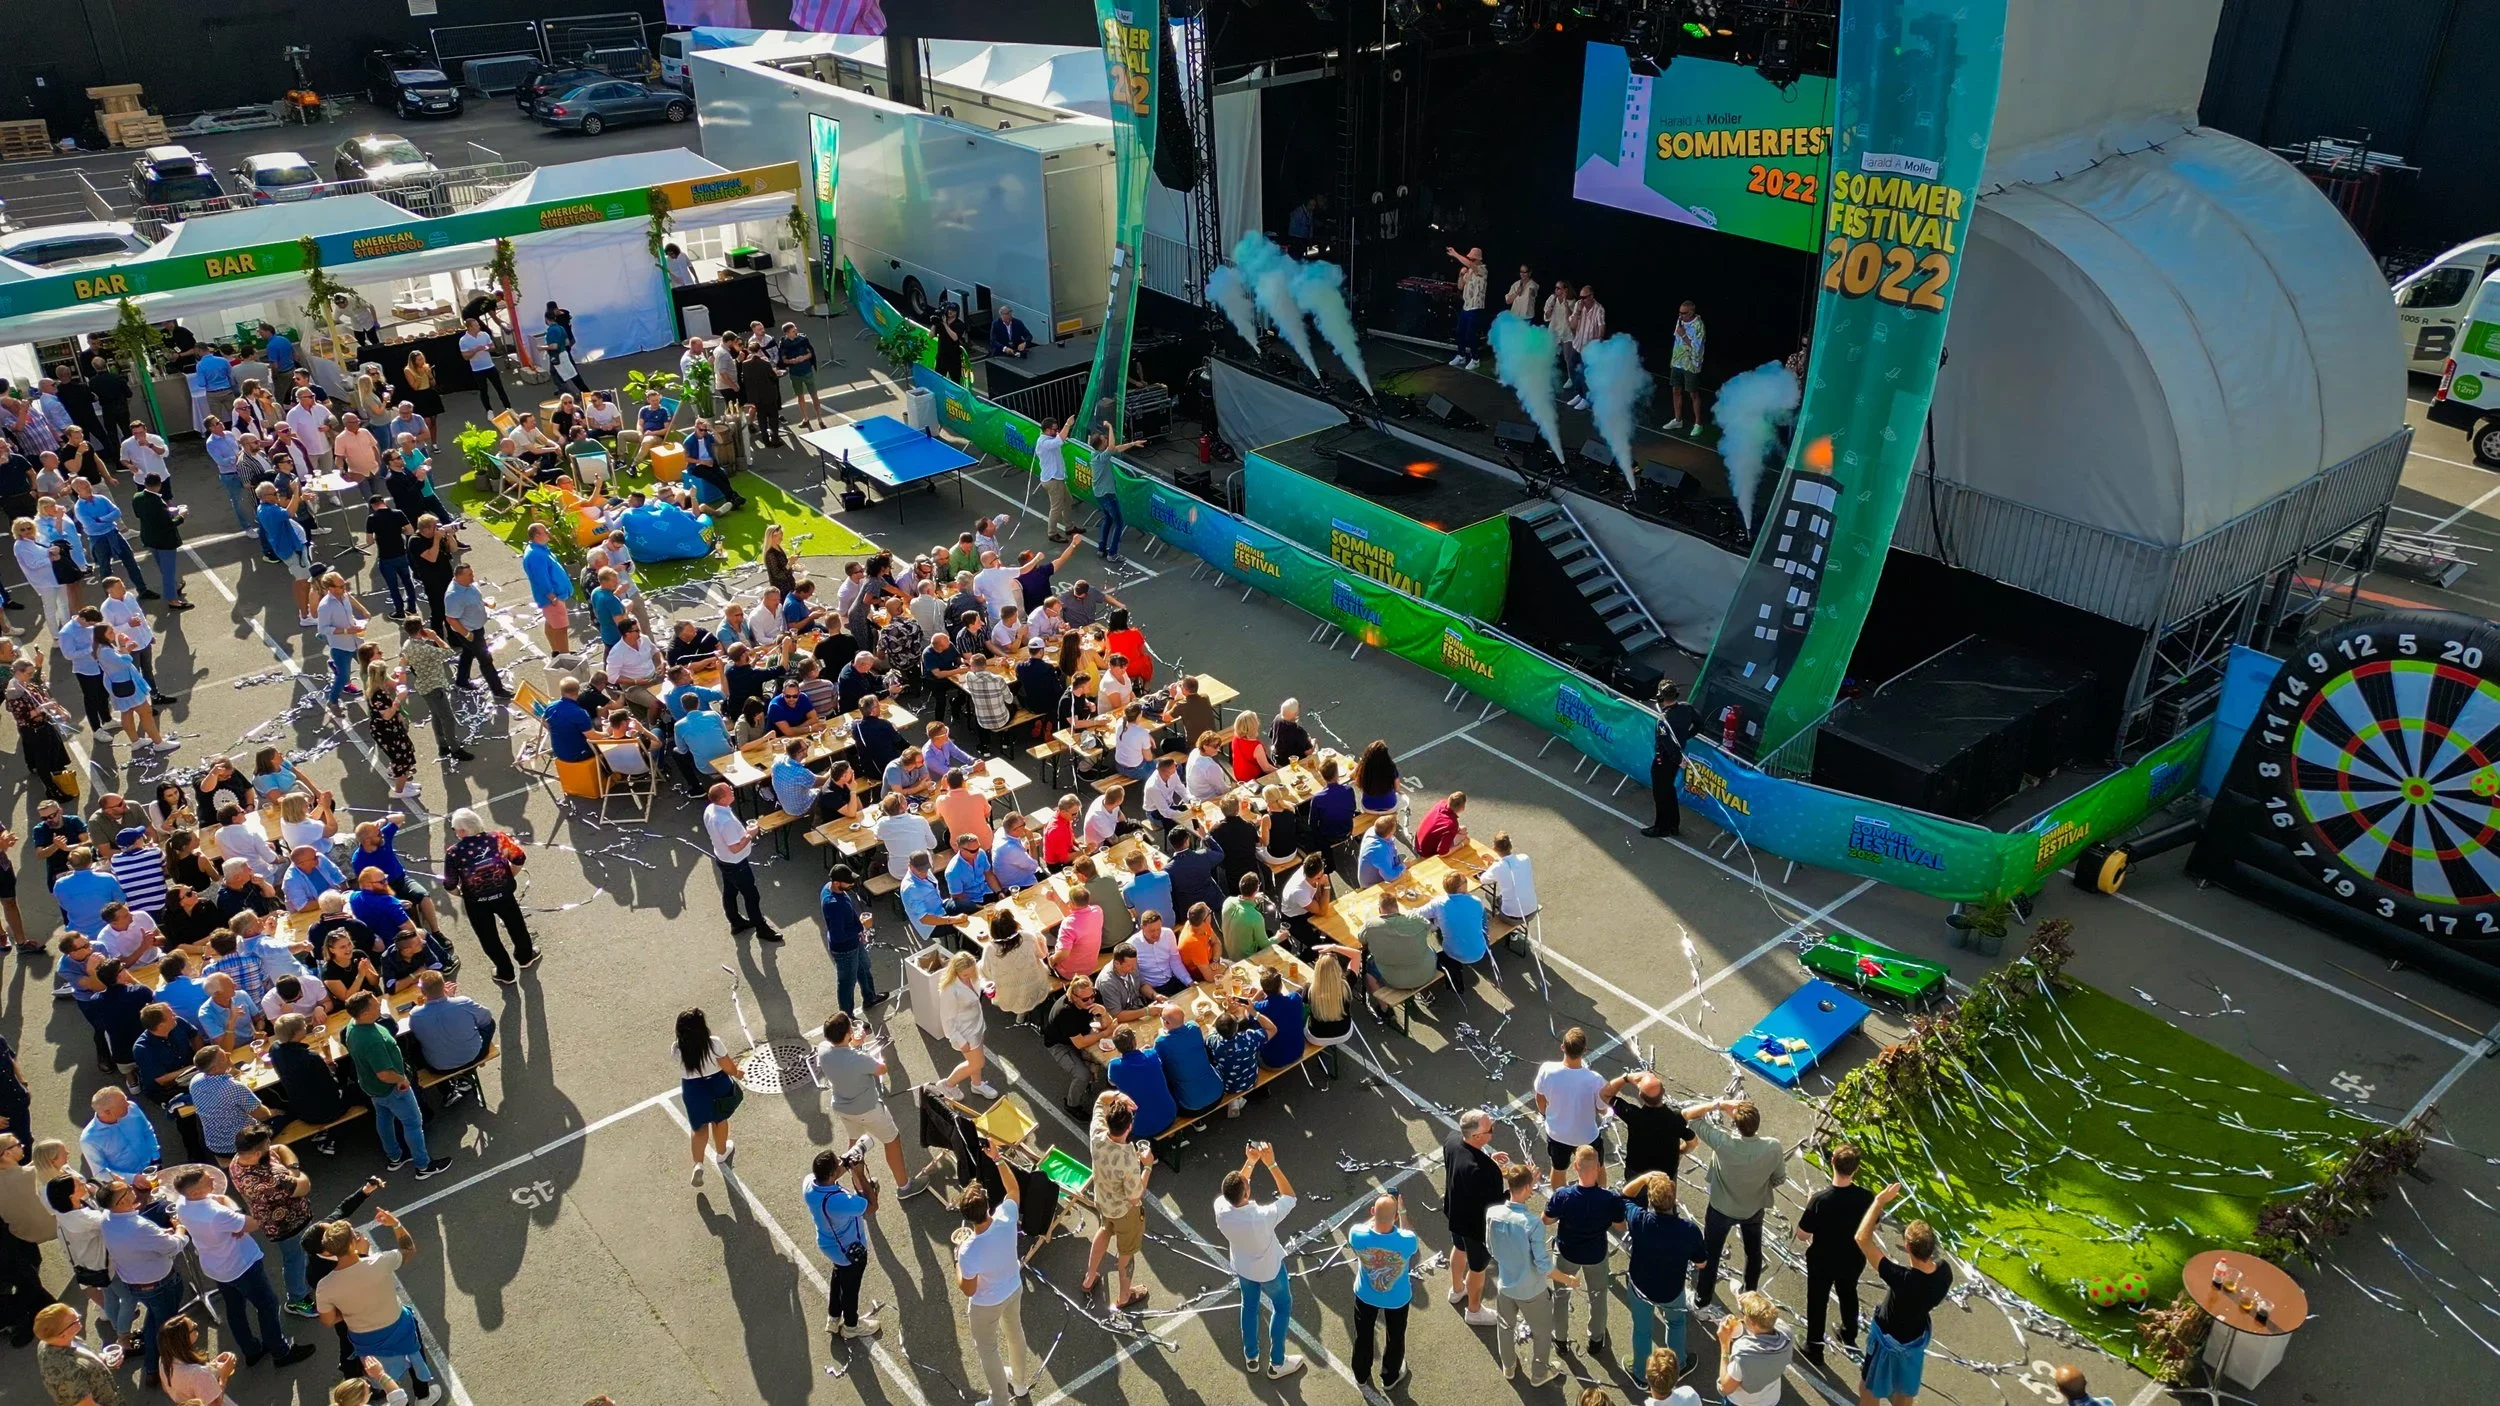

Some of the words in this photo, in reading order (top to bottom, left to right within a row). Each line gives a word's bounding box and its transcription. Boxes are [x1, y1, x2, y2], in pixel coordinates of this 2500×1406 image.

[692, 185, 752, 204] STREETFOOD
[1747, 164, 1819, 204] 2022
[1833, 170, 1962, 221] SOMMER
[539, 203, 594, 221] AMERICAN
[540, 210, 603, 230] STREETFOOD
[352, 231, 413, 250] AMERICAN
[1828, 202, 1957, 255] FESTIVAL
[353, 239, 424, 259] STREETFOOD
[204, 253, 257, 278] BAR
[1823, 237, 1951, 313] 2022
[73, 274, 129, 299] BAR
[946, 403, 972, 423] FESTIVA
[1075, 469, 1092, 487] FEST
[1331, 529, 1395, 567] SOMMER
[1234, 548, 1280, 578] FESTIVAL
[1332, 595, 1382, 626] FESTIVAL
[1444, 633, 1475, 658] SOMMER
[2338, 634, 2378, 660] 12
[2398, 634, 2418, 655] 5
[2440, 640, 2484, 669] 20
[1442, 641, 1494, 679] FESTIVAL
[2307, 652, 2329, 674] 9
[2278, 675, 2309, 708] 14
[1556, 699, 1612, 742] FESTIVAL
[2262, 713, 2290, 744] 11
[2258, 762, 2281, 778] 8
[1685, 767, 1751, 816] FESTIVAL
[2266, 796, 2294, 829] 16
[1853, 823, 1914, 846] SOMMER
[1849, 833, 1946, 871] FESTIVAL
[2293, 841, 2317, 859] 7
[2322, 867, 2356, 898] 19
[2376, 898, 2397, 918] 3
[2419, 912, 2458, 935] 17
[2475, 912, 2499, 933] 2
